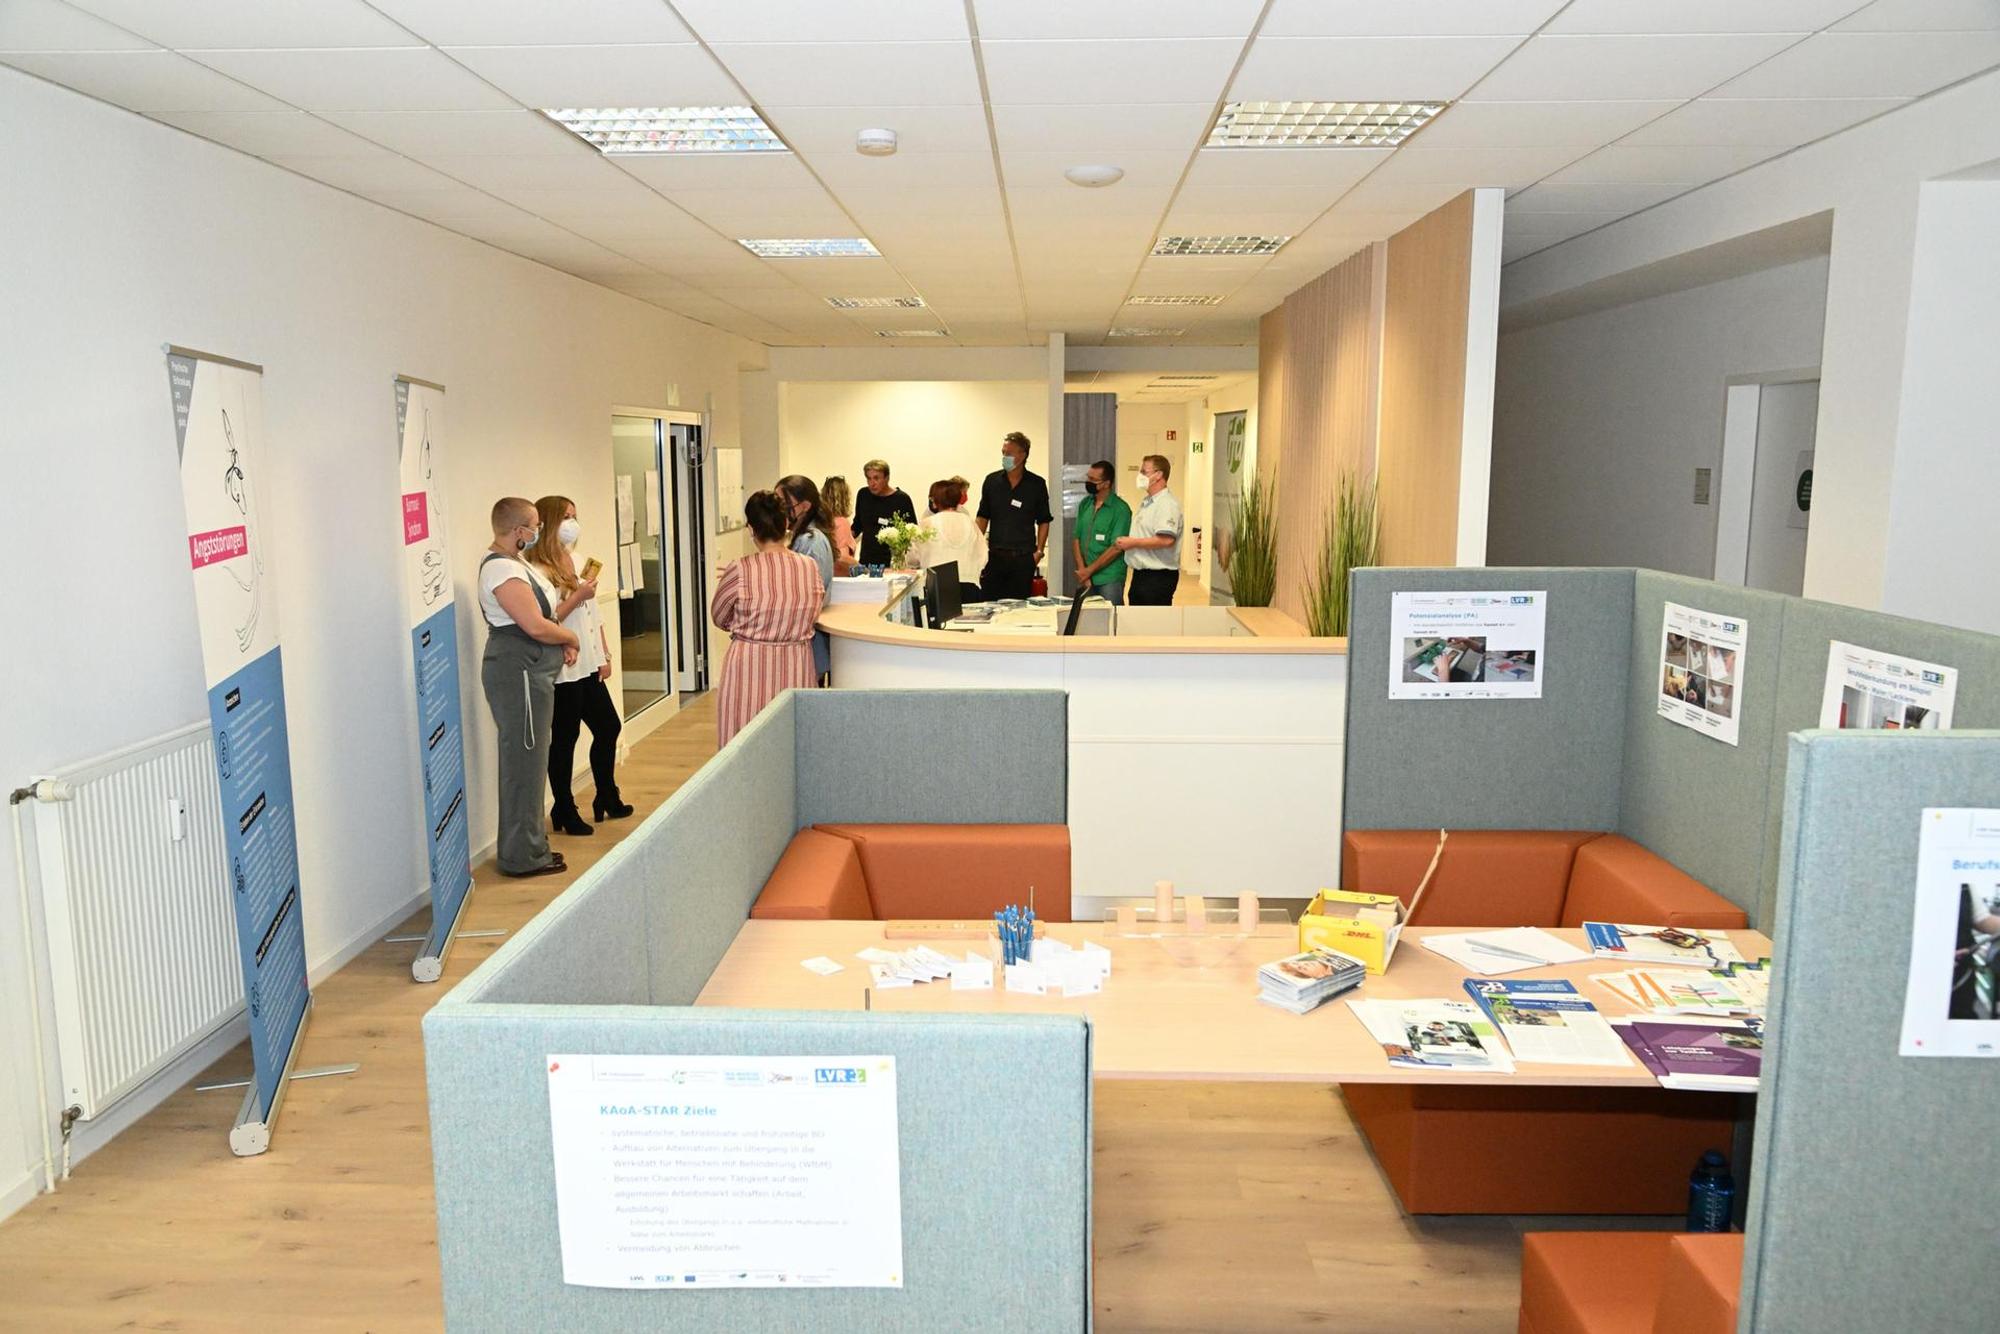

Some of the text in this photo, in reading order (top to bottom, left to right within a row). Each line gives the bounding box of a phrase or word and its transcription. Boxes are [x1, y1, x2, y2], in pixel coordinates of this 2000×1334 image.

[193, 531, 244, 563] Angststörungen
[816, 1068, 848, 1082] LVR
[599, 1105, 718, 1116] KAoA-STAR Ziele
